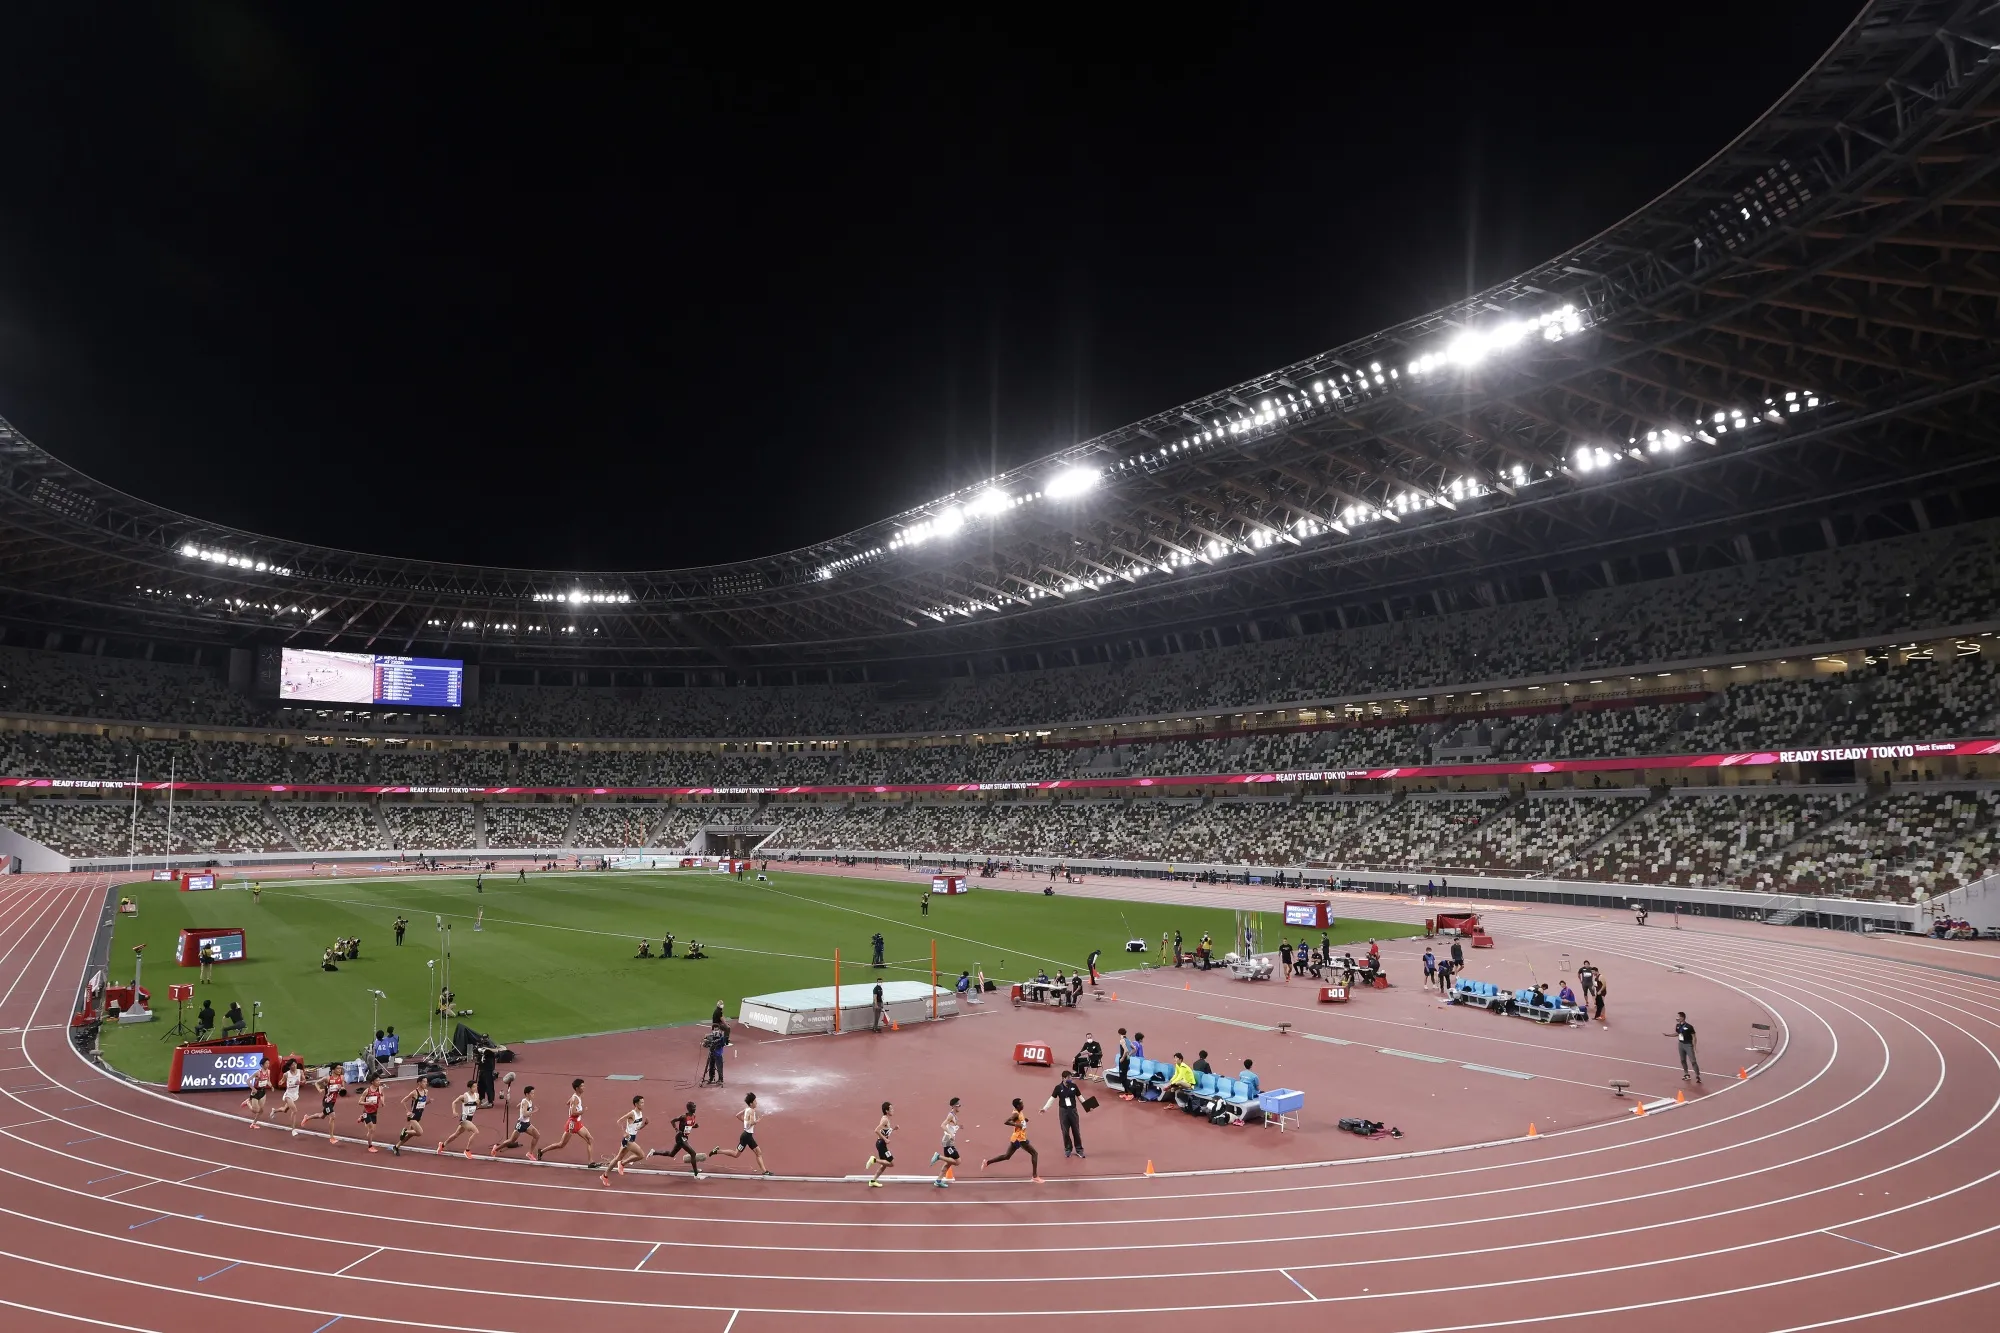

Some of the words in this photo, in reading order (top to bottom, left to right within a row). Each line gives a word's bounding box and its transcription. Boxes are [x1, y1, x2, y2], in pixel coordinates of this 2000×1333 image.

[1780, 750, 1818, 763] READY
[1821, 747, 1870, 761] STEADY
[1870, 745, 1914, 758] TOKYO
[1931, 743, 1955, 751] Events
[1276, 773, 1296, 782] READY
[1297, 772, 1322, 781] STEADY
[1323, 771, 1345, 780] TOKYO
[75, 780, 100, 788] STEADY
[753, 1012, 778, 1025] MONDO
[214, 1055, 257, 1069] 6:05.3
[181, 1074, 216, 1087] Men's
